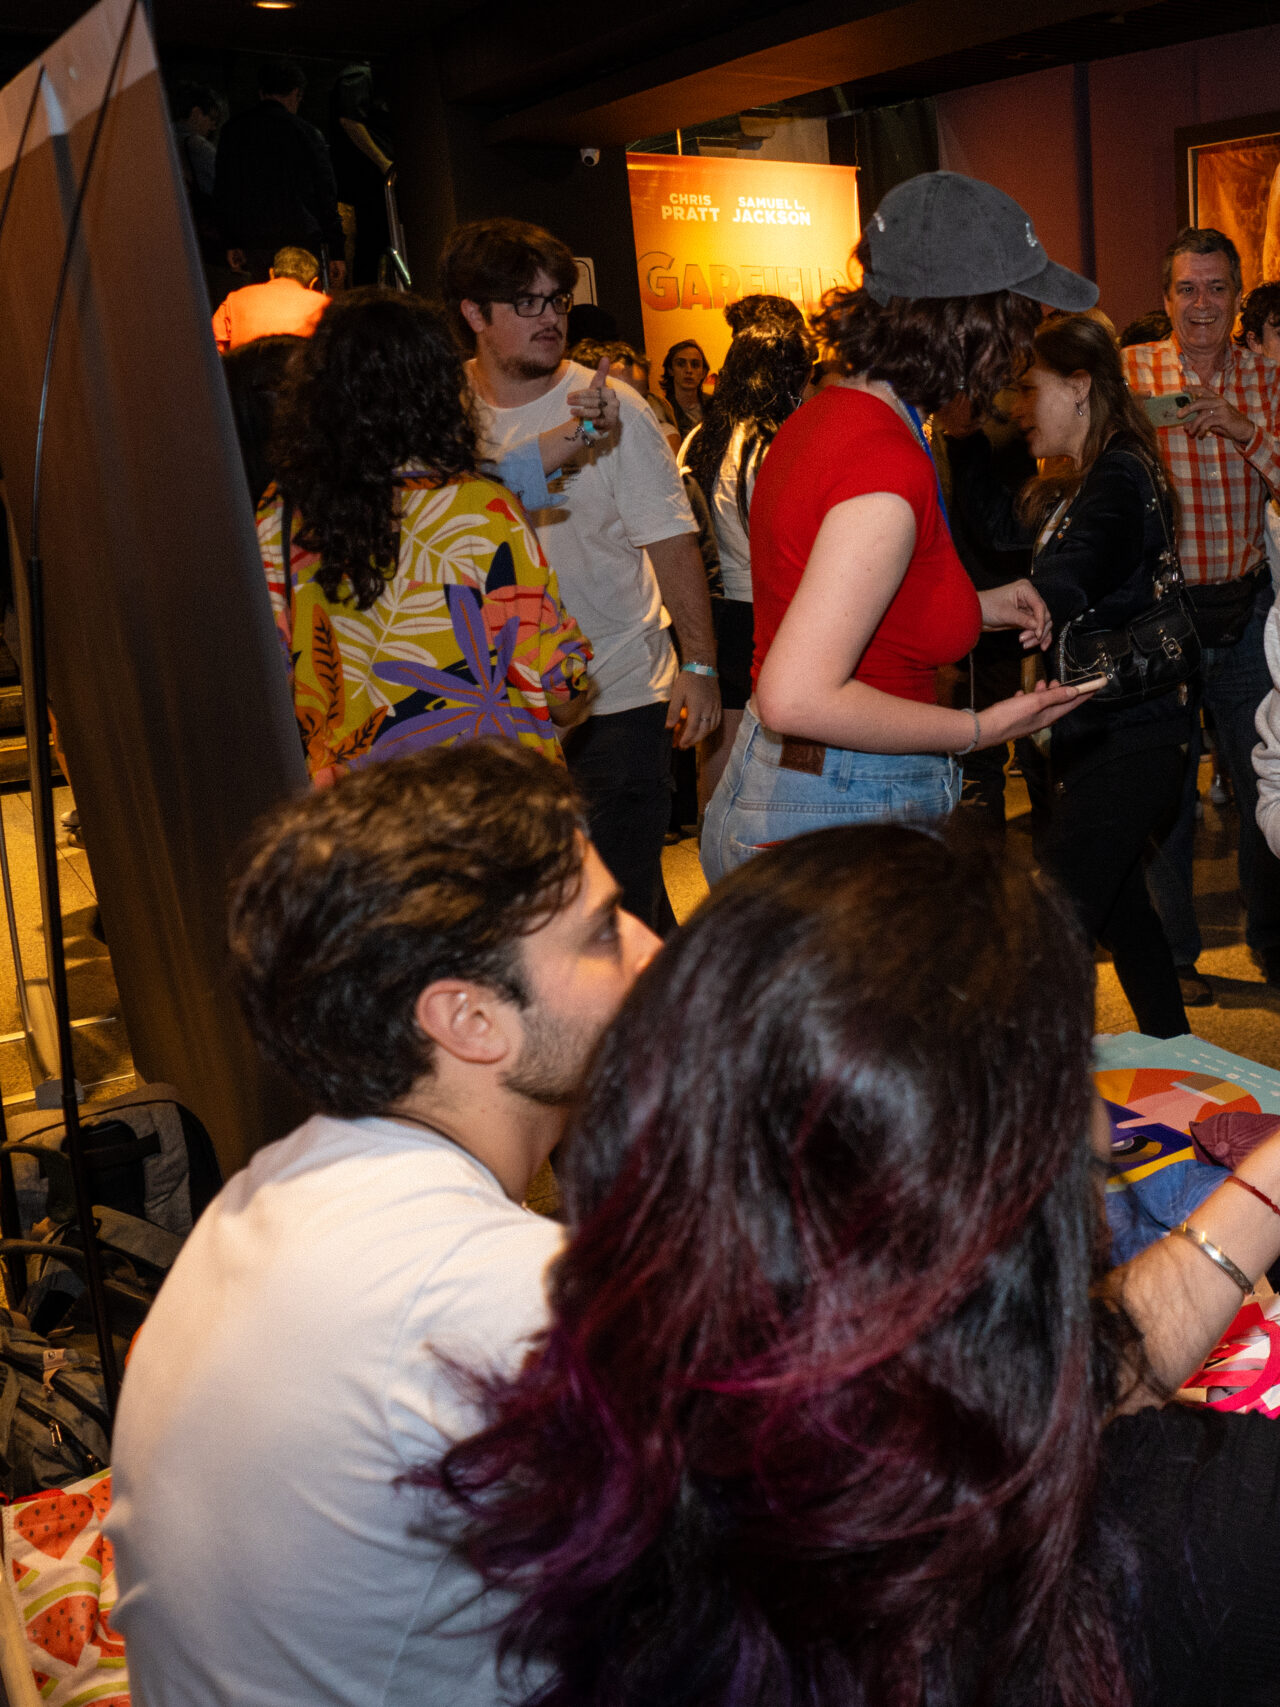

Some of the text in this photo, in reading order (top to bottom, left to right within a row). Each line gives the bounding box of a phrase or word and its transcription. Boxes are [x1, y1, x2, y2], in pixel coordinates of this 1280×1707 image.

[669, 193, 806, 210] CHRIS SAMUEL L.
[661, 205, 811, 226] PRATT JACKSON
